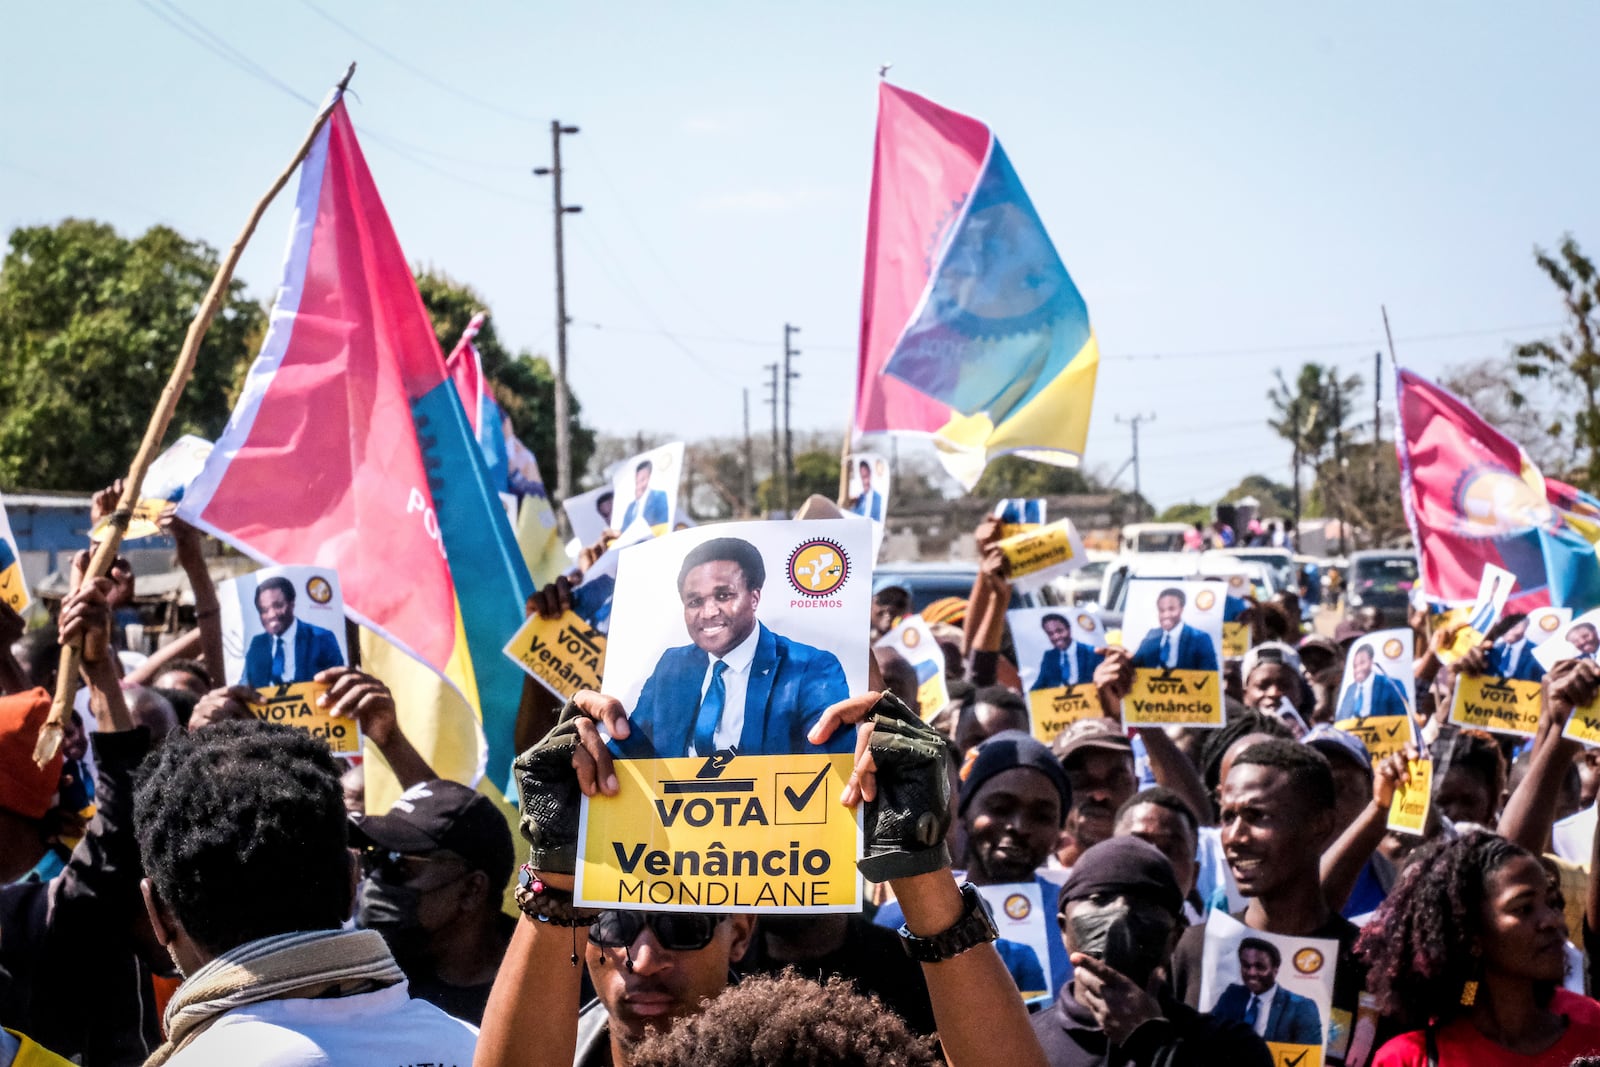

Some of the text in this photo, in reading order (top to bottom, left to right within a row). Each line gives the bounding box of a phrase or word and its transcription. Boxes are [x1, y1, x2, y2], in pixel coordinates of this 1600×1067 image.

[790, 600, 842, 608] PODEMOS
[557, 629, 599, 672] VOTA
[1147, 683, 1188, 694] VOTA
[1480, 689, 1518, 704] VOTA
[257, 703, 313, 721] VOTA
[1052, 700, 1090, 713] VOTA
[1133, 699, 1213, 714] Venâncio
[1464, 702, 1538, 723] Venâncio
[654, 796, 769, 828] VOTA
[612, 841, 831, 877] Venâncio
[618, 879, 830, 906] MONDLANE
